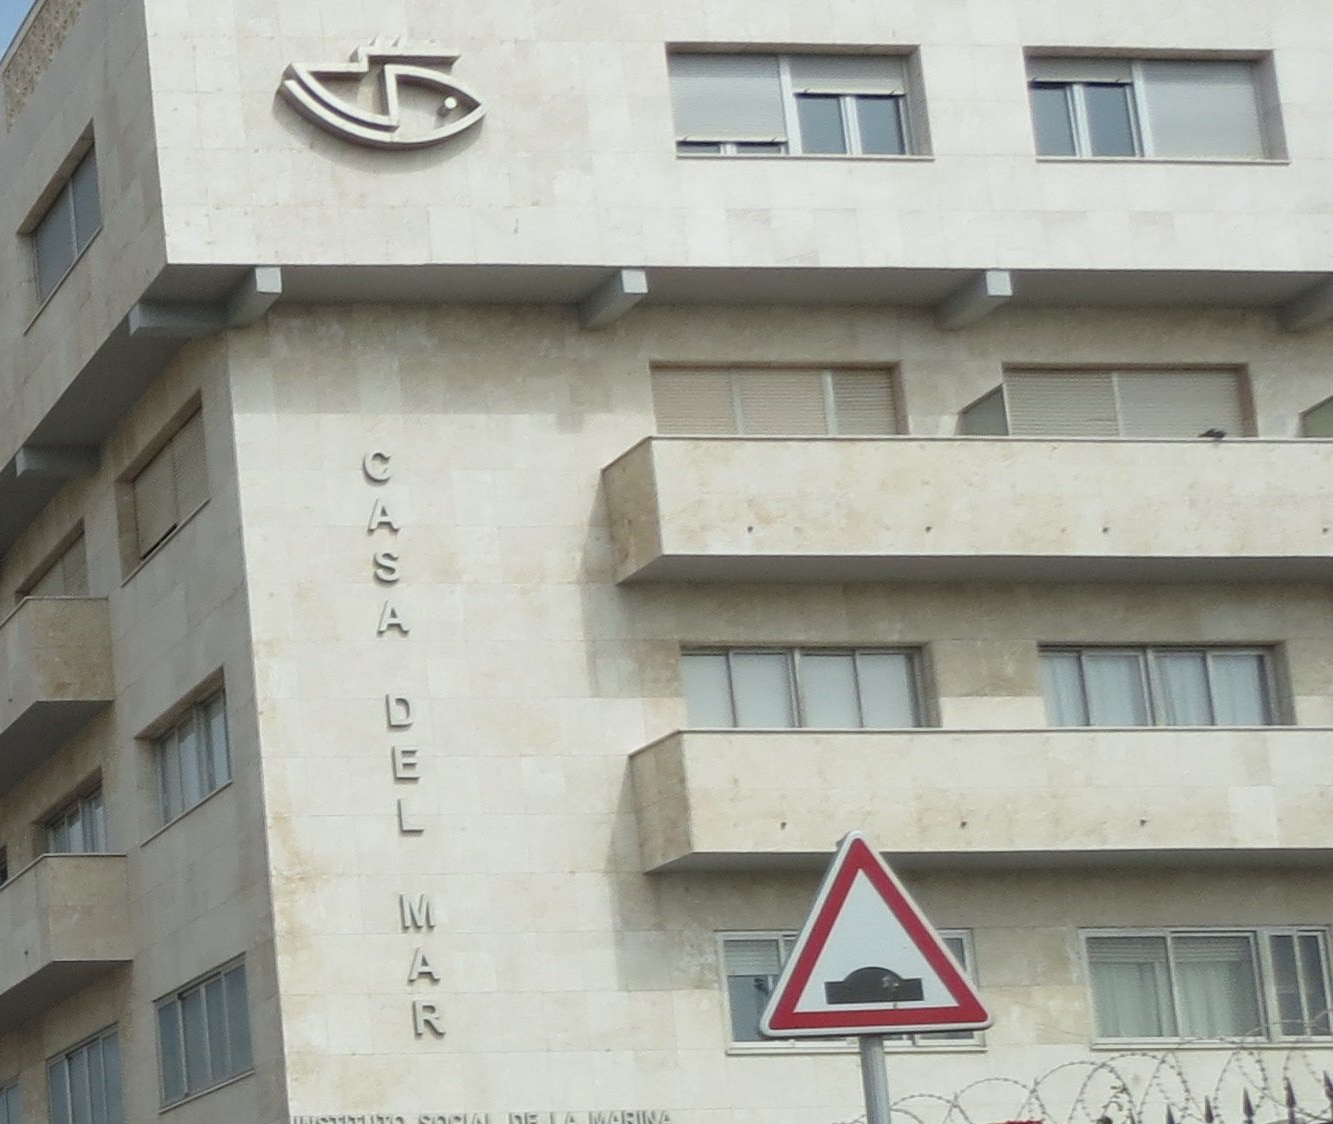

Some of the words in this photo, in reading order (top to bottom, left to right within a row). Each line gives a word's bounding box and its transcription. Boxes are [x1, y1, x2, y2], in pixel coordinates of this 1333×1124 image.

[362, 449, 411, 636] CASA
[384, 693, 425, 835] DEL
[399, 893, 446, 1038] MAR
